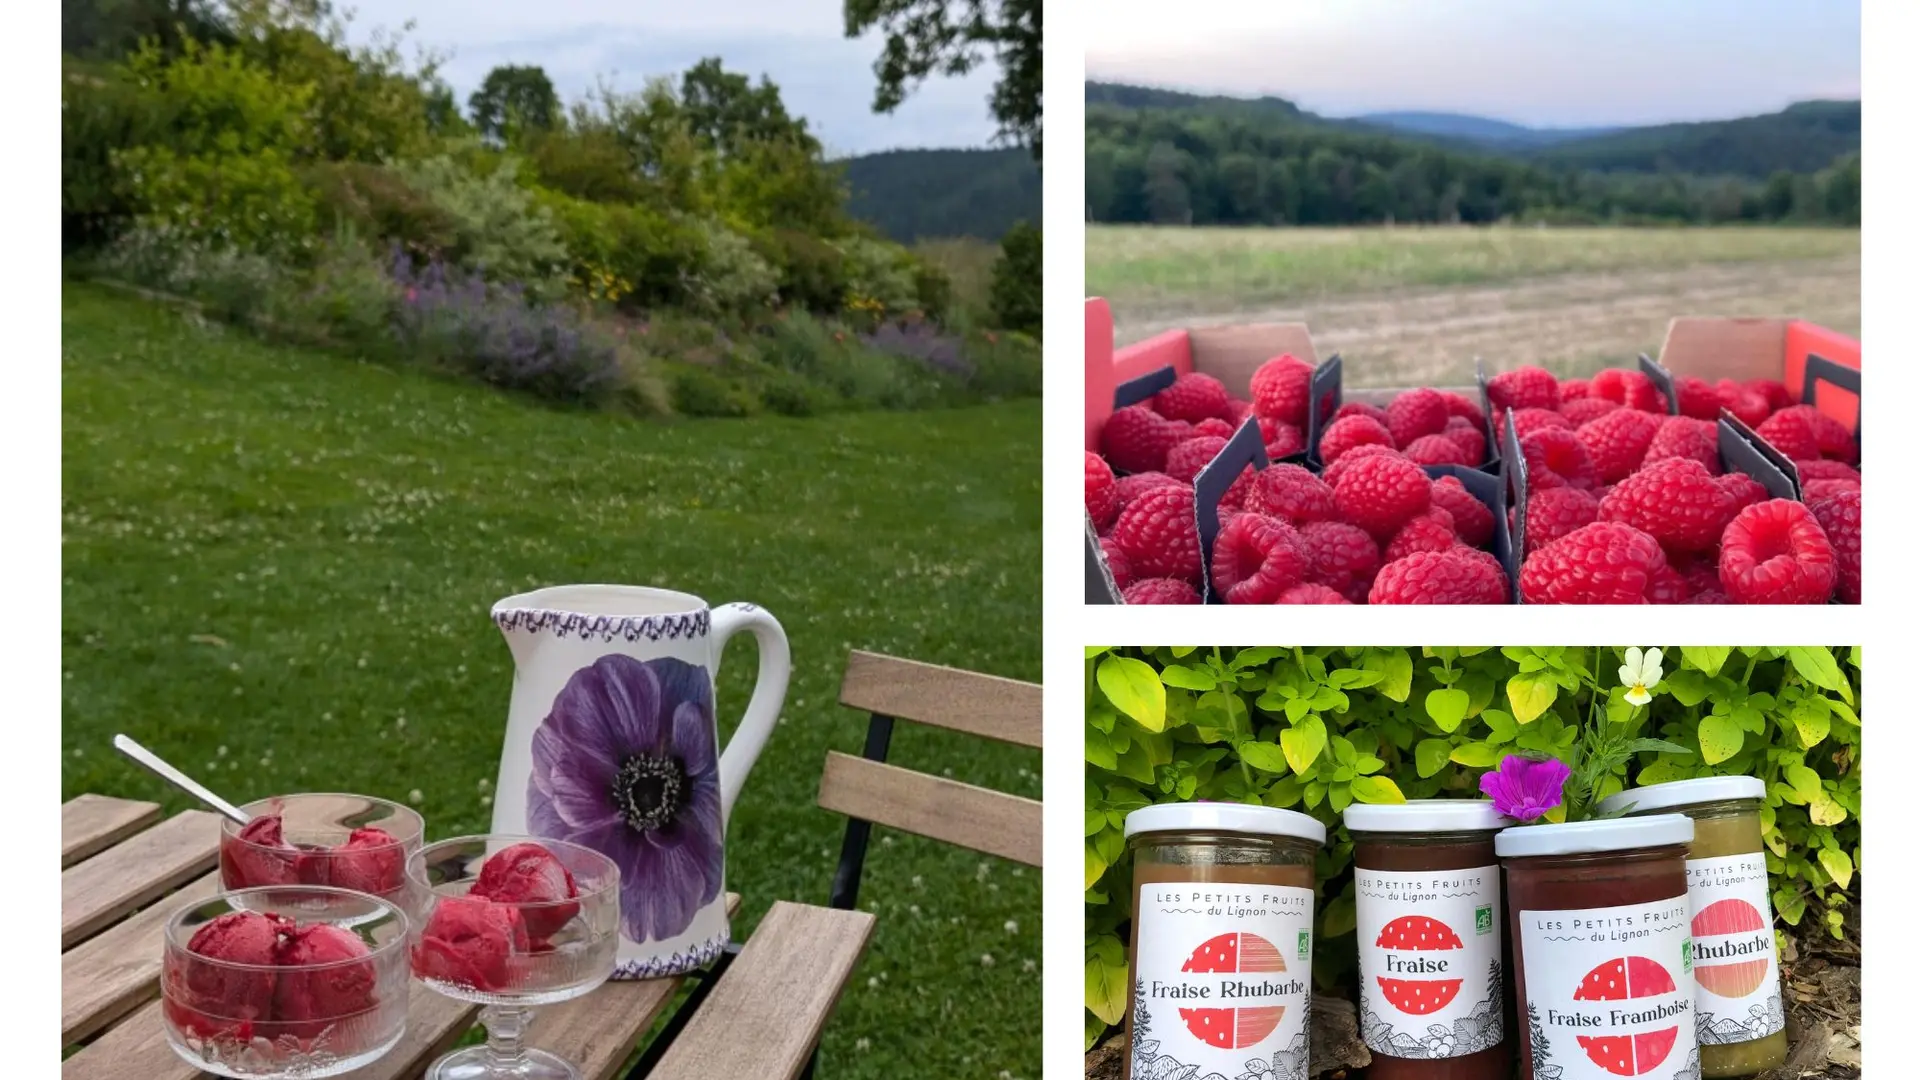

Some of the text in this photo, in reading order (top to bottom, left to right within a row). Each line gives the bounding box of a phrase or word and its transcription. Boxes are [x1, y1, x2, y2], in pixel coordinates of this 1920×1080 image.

[1377, 880, 1422, 890] PETITS
[1432, 878, 1481, 888] FRUITS
[1699, 876, 1745, 888] du Lignon
[1157, 892, 1304, 906] LES PETITS FRUITS
[1388, 892, 1437, 903] du Lignon
[1207, 905, 1266, 918] du Lignon
[1537, 907, 1684, 930] LES PETITS FRUITS
[1590, 929, 1650, 943] du Lignon
[1387, 954, 1449, 974] Fraise
[1152, 978, 1305, 999] Fraise Rhubarbe
[1548, 998, 1689, 1028] Fraise Framboise
